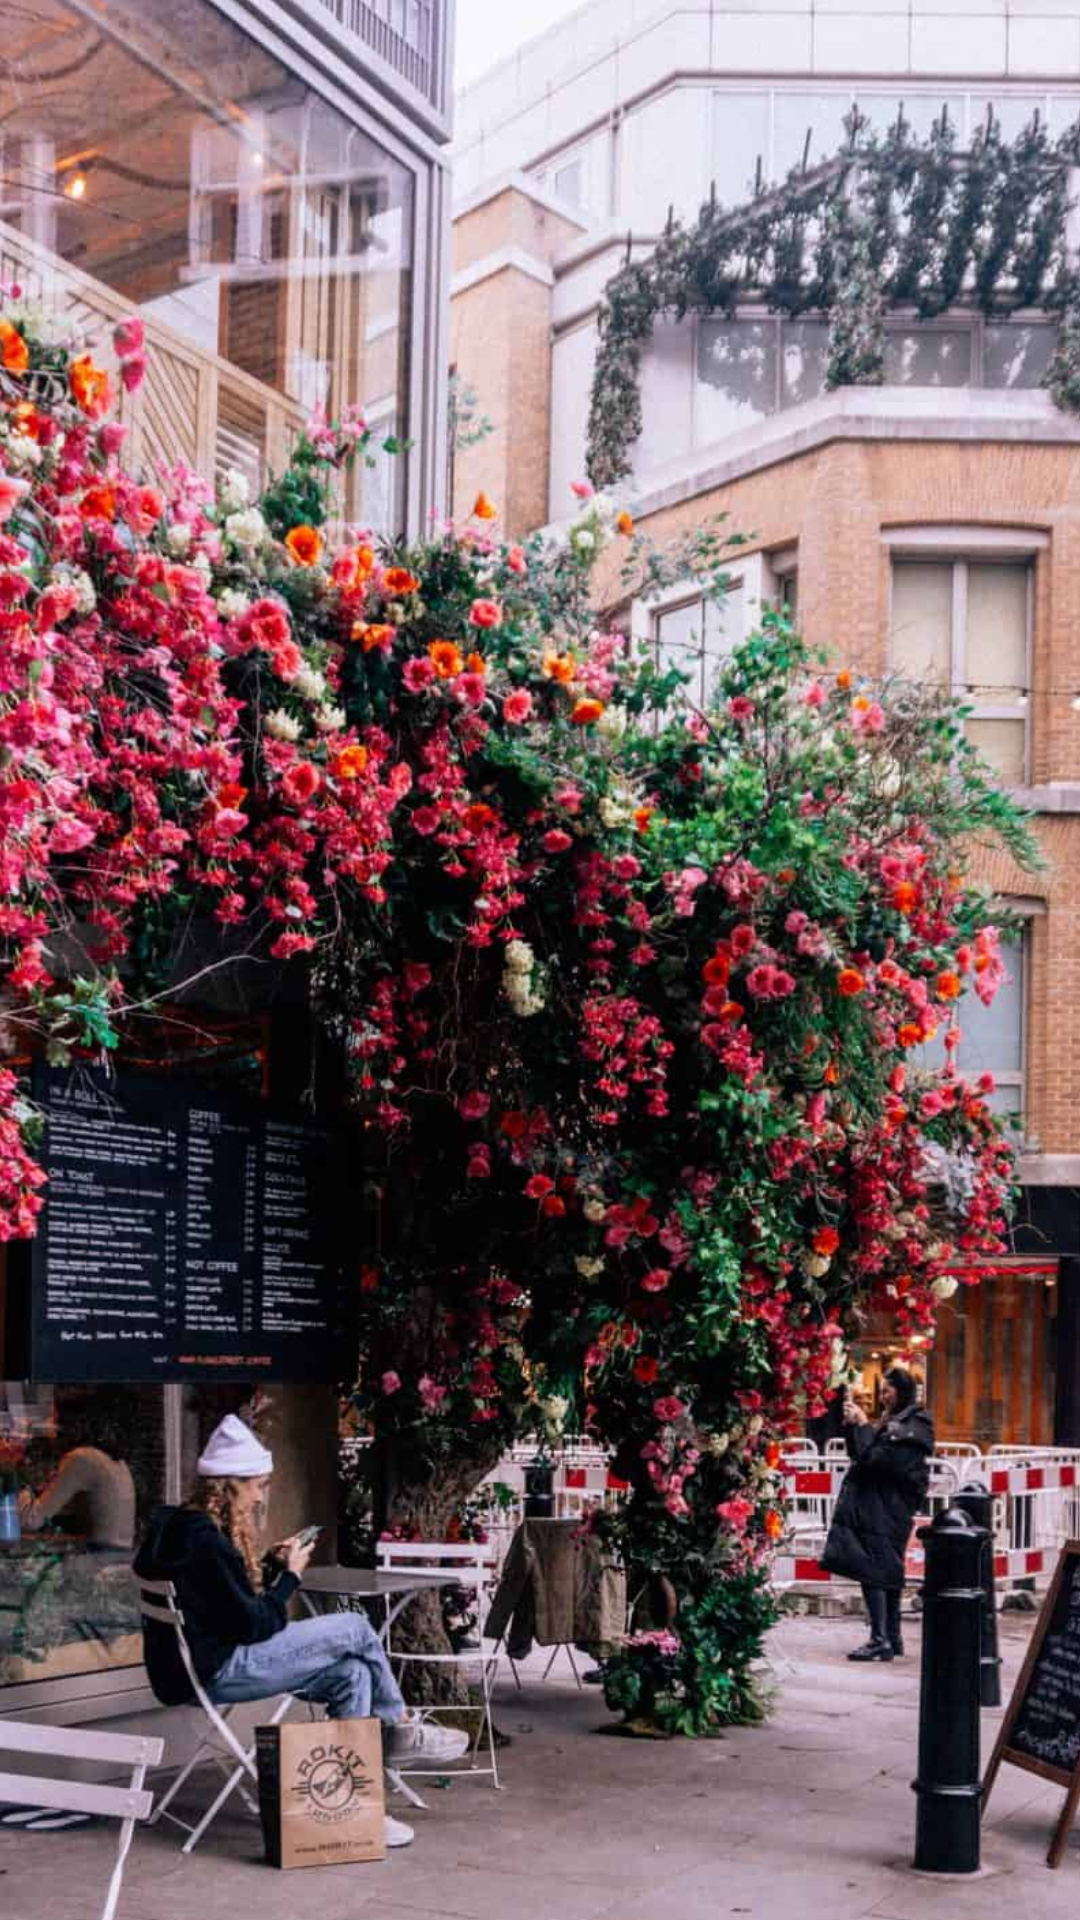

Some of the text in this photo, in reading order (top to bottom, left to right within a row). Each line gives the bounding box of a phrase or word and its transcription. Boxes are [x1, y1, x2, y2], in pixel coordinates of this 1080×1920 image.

[189, 1109, 220, 1122] COFFEE
[48, 1168, 94, 1182] ON TOAST
[186, 1260, 239, 1273] NOT COFFEE
[297, 1744, 366, 1777] ROKIT
